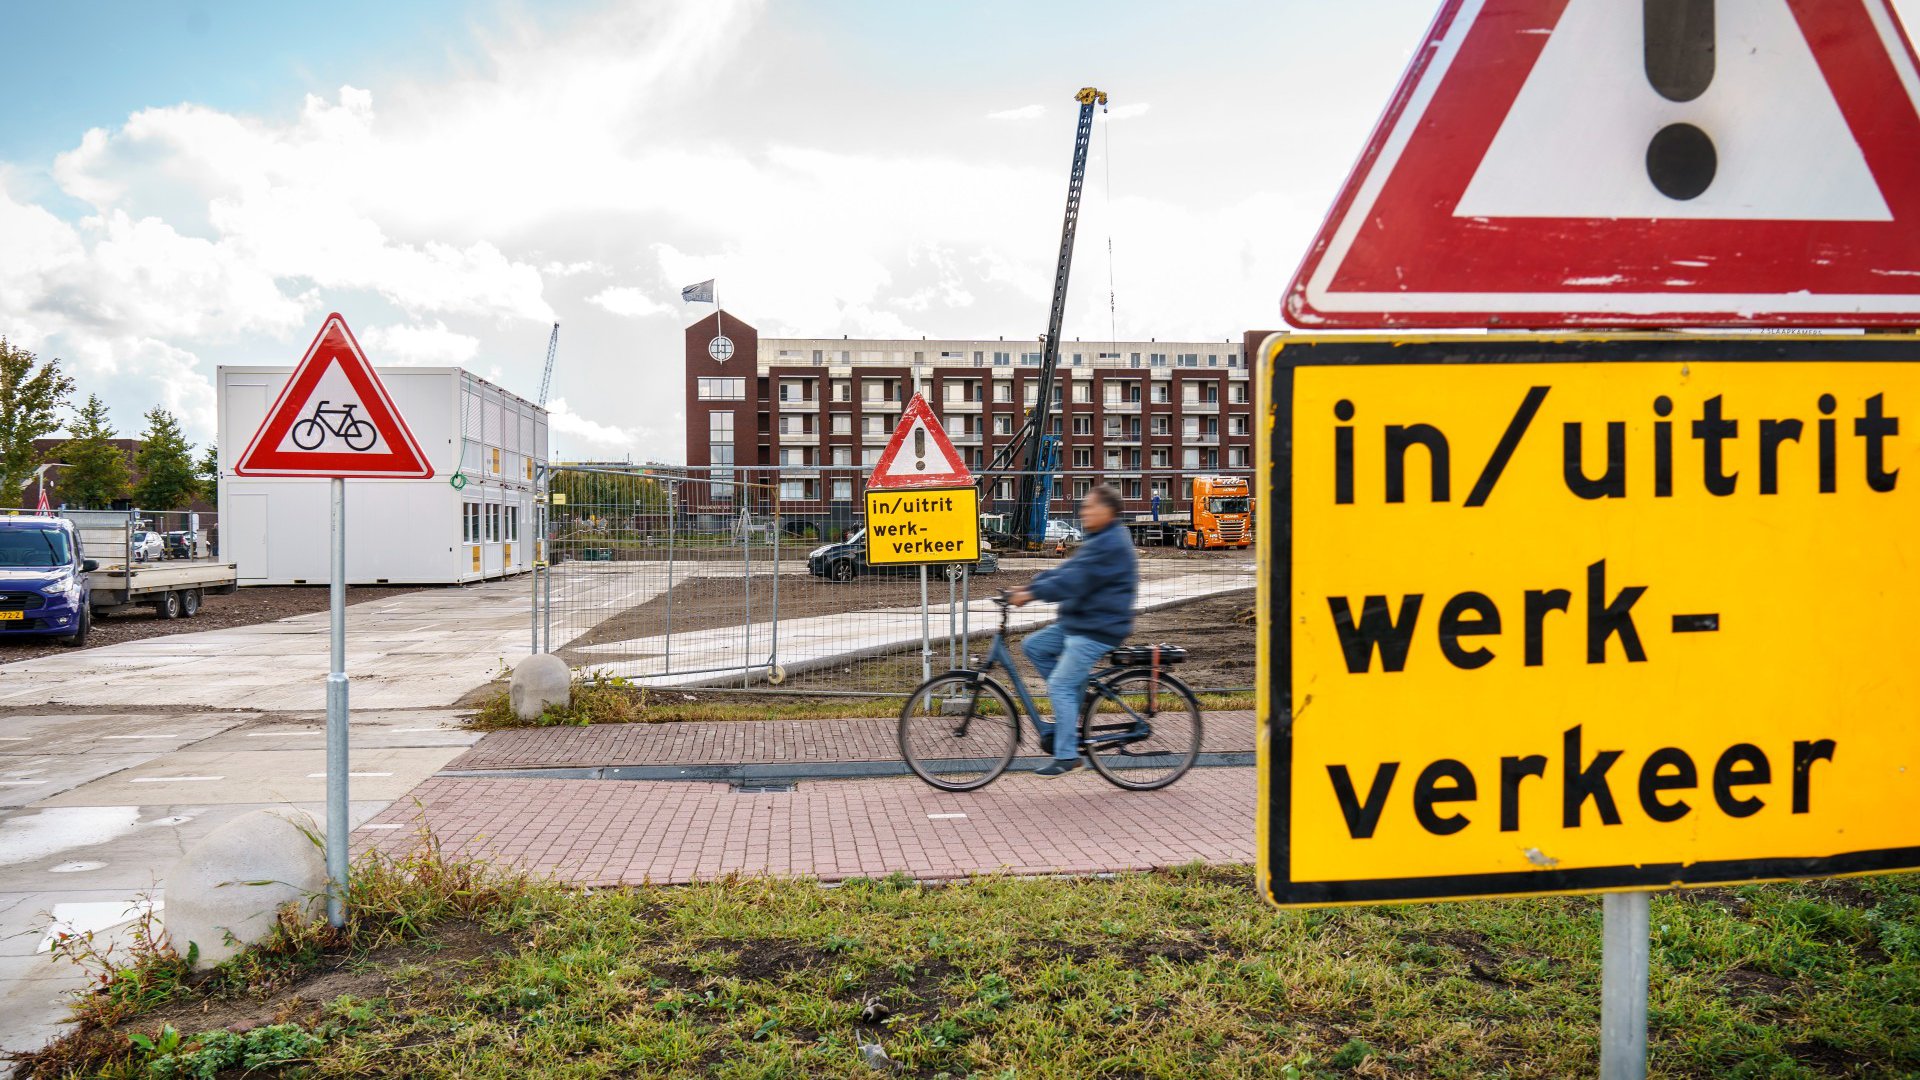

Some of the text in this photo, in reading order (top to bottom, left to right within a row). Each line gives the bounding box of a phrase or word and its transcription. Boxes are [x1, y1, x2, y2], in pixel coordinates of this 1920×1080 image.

[1330, 384, 1901, 508] in/uitrit
[872, 497, 953, 515] in/uitrit
[873, 520, 928, 537] werk-
[892, 537, 964, 554] verkeer
[1326, 557, 1721, 674] werk-
[1326, 723, 1838, 840] verkeer
